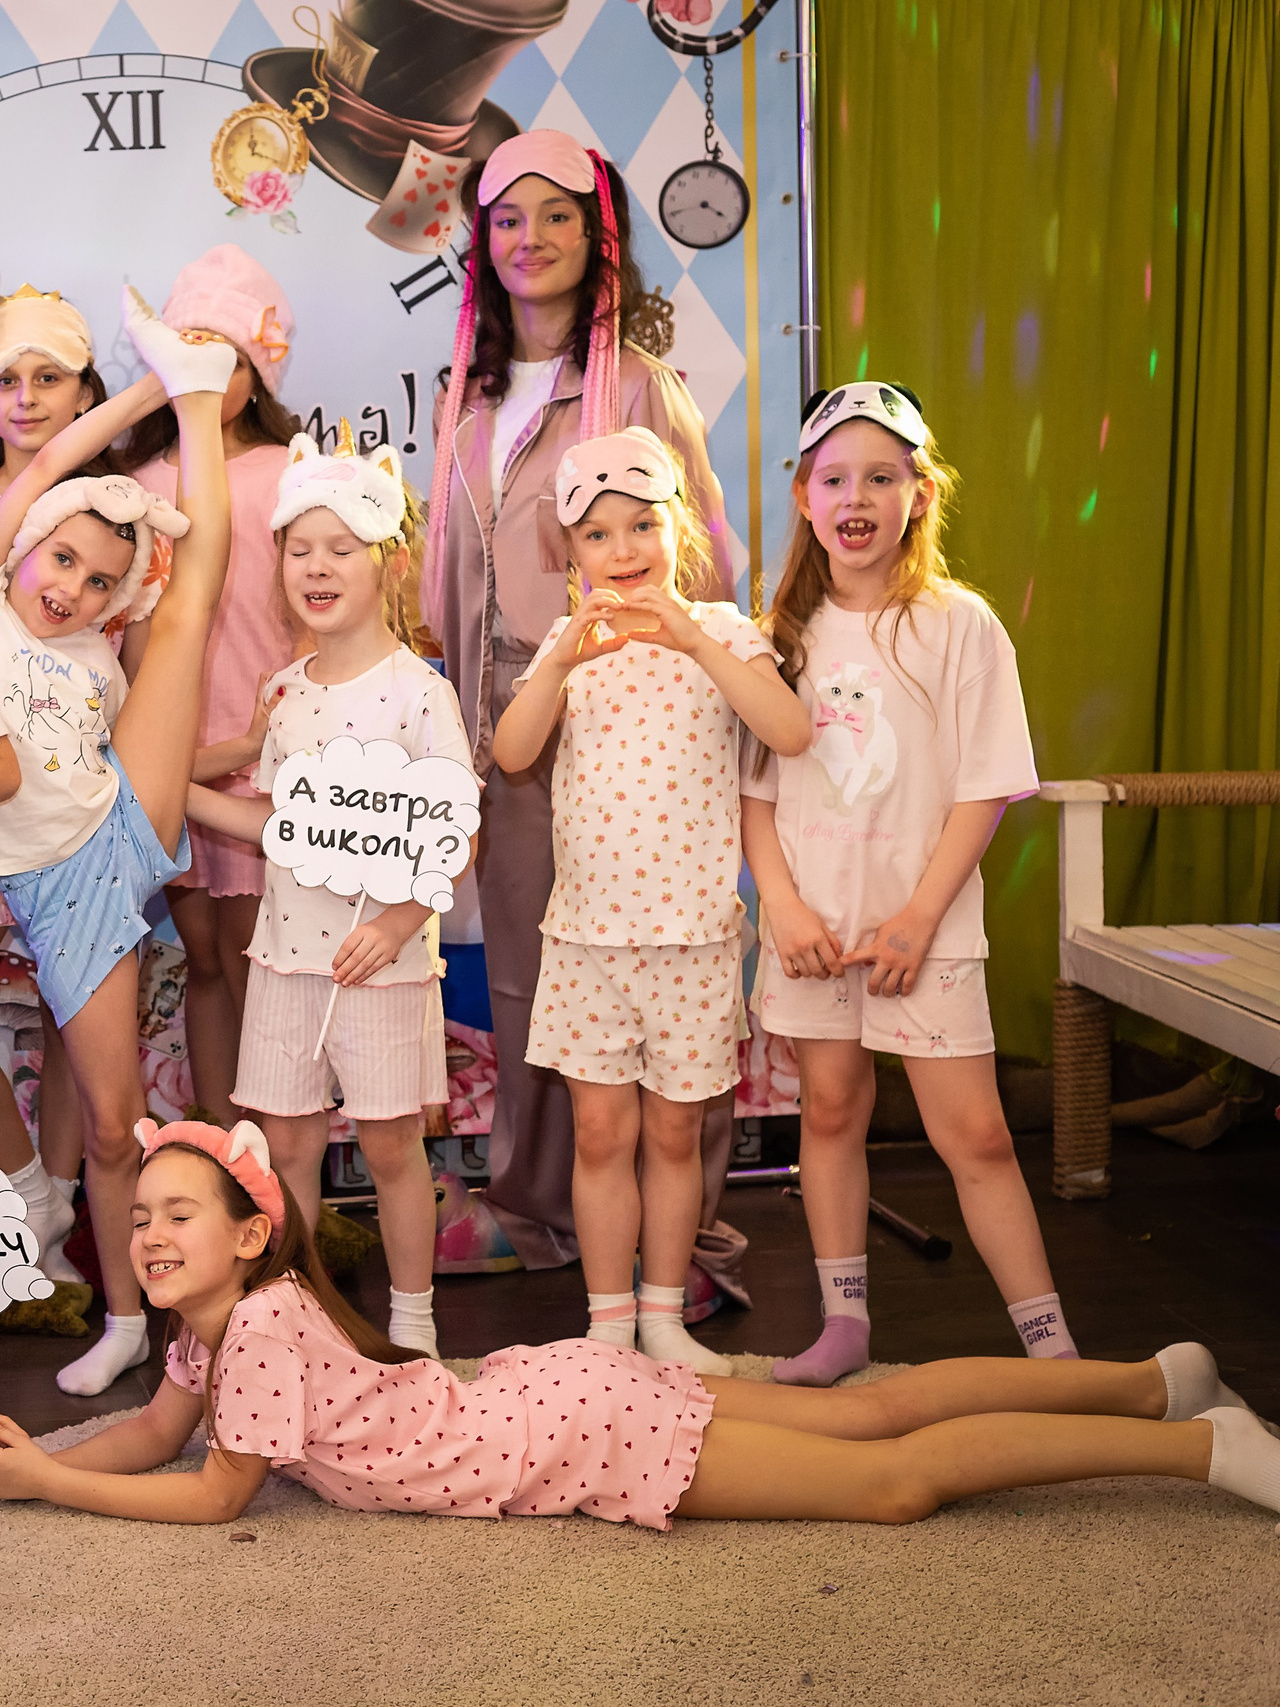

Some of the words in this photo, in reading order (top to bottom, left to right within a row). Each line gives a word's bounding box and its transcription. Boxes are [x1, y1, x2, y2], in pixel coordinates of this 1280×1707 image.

[82, 90, 166, 152] XII
[289, 777, 316, 803] А
[329, 785, 454, 832] завтра
[278, 820, 295, 841] в
[308, 826, 424, 876] школу
[832, 1276, 867, 1287] DANC
[843, 1288, 866, 1299] GIR
[1026, 1326, 1056, 1345] GIRL
